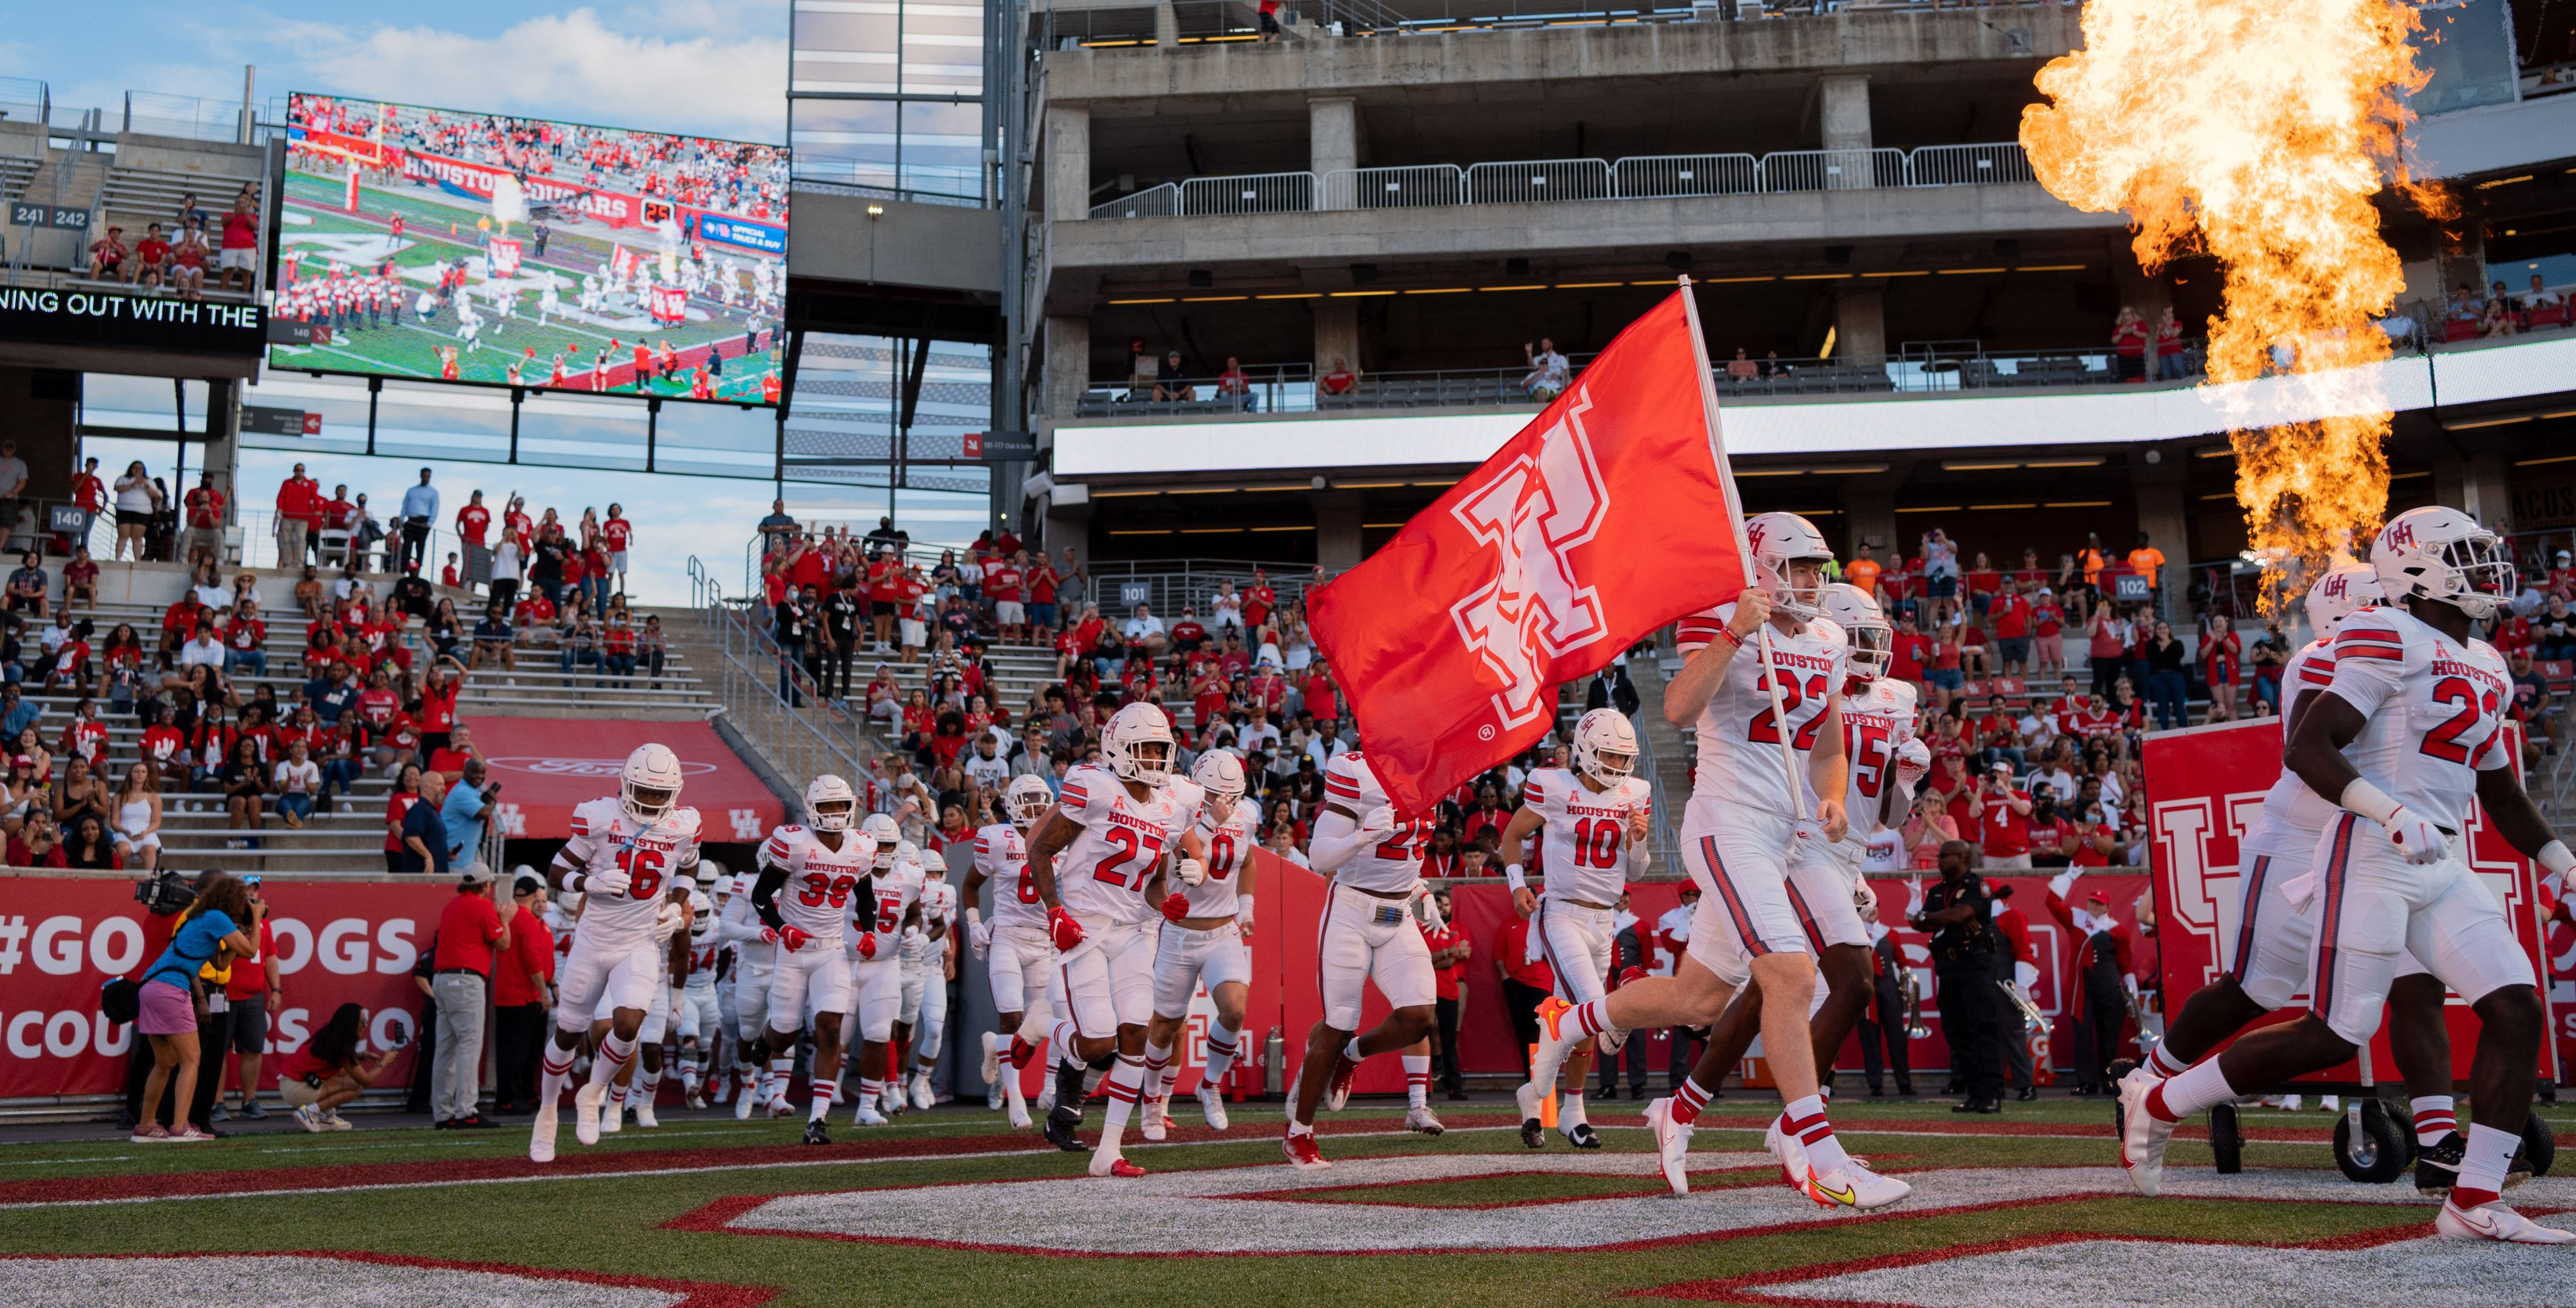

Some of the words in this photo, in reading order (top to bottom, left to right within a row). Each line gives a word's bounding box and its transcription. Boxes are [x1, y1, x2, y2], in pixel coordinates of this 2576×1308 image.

[17, 206, 44, 223] 241
[56, 212, 86, 226] 242
[67, 293, 125, 318] OUT
[131, 297, 198, 324] WITH
[206, 303, 258, 328] THE
[55, 511, 82, 526] 140
[2388, 521, 2417, 557] UH
[1124, 587, 1145, 601] 101
[2120, 580, 2148, 595] 102
[2324, 573, 2348, 601] UH
[2431, 660, 2507, 697] HOUSTON
[1748, 667, 1831, 751] 22
[529, 760, 623, 775] For
[728, 809, 762, 840] UH
[1108, 811, 1168, 840] HOUSTON
[1566, 804, 1629, 819] HOUSTON
[1995, 806, 2008, 828] 4
[1574, 818, 1621, 868] 10
[804, 862, 860, 875] HOUSTON
[1093, 825, 1163, 892] 27
[611, 849, 665, 900] 16
[799, 872, 857, 909] 39
[2031, 1034, 2049, 1058] G
